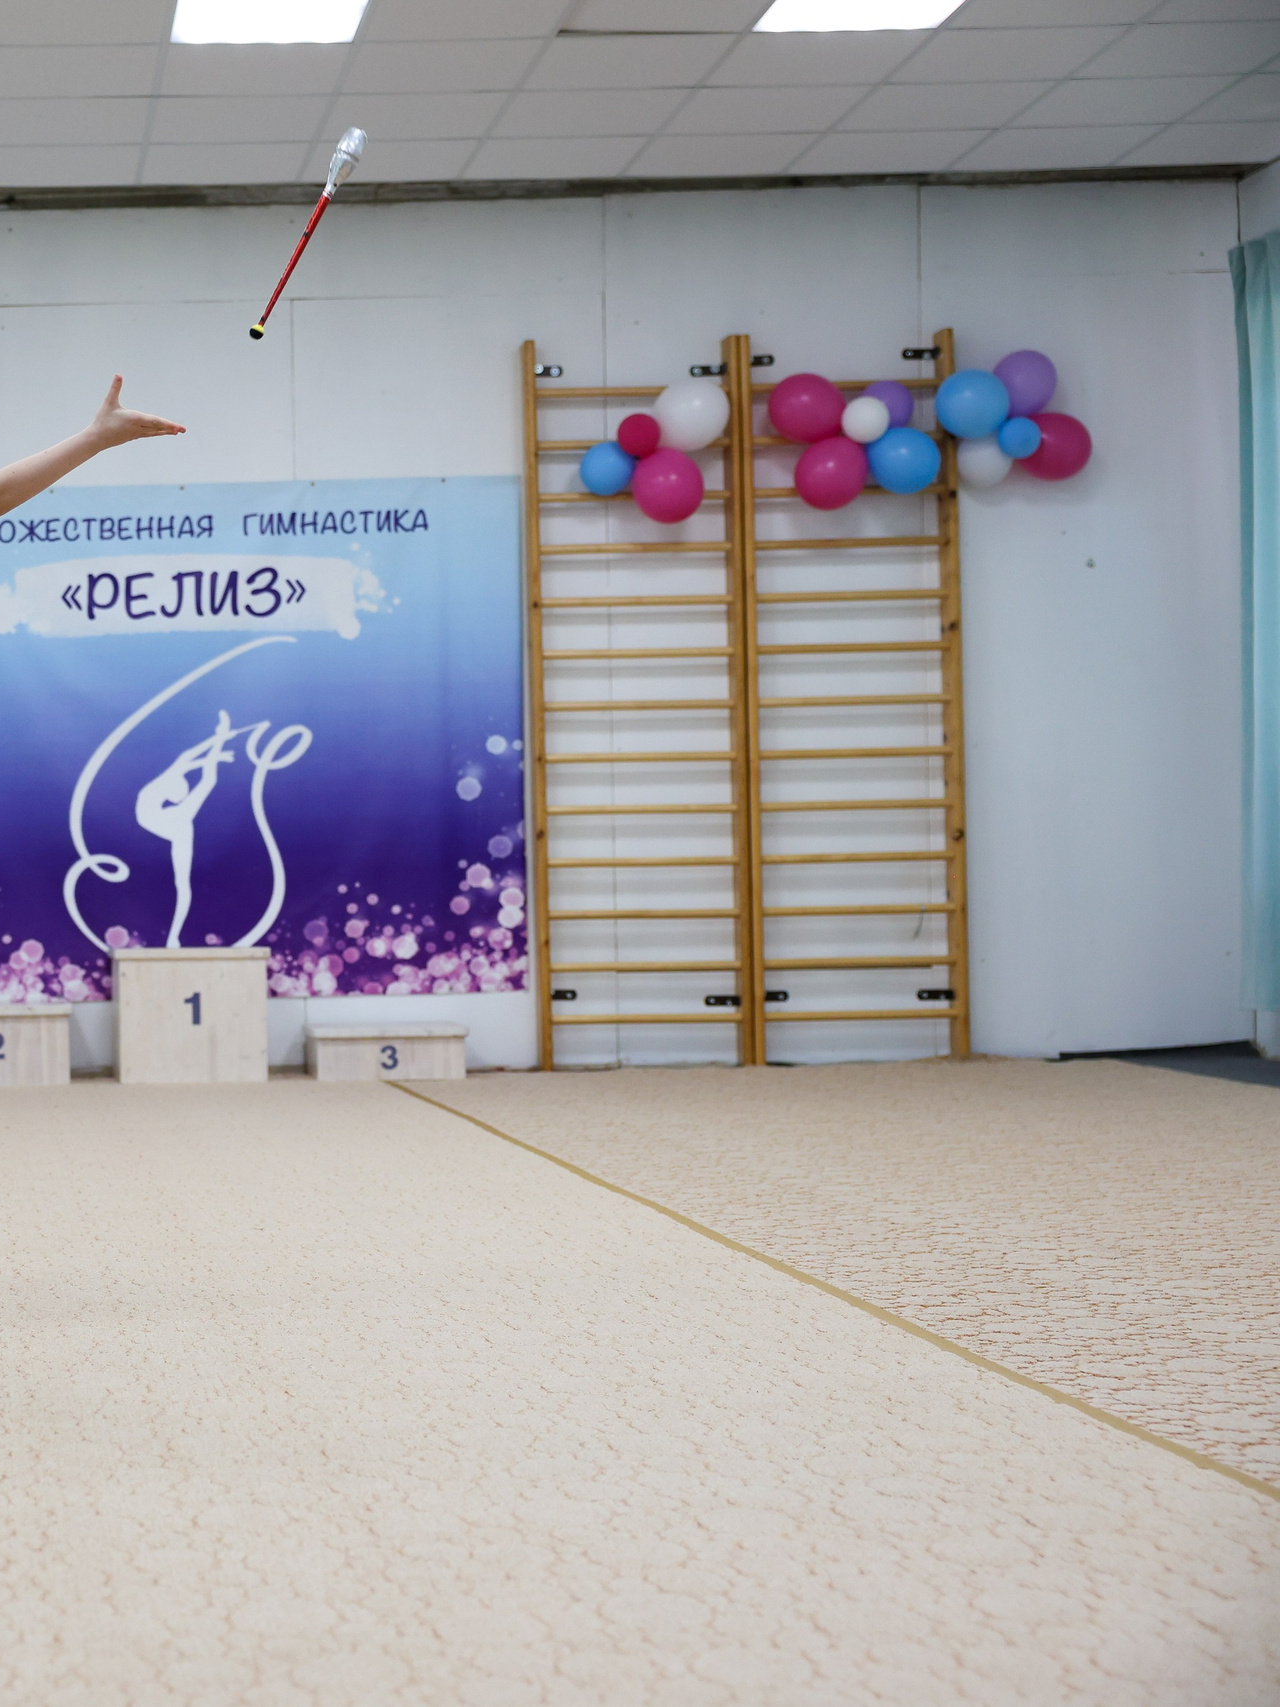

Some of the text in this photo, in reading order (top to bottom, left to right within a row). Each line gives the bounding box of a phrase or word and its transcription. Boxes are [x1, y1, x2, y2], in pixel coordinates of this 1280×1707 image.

[242, 508, 429, 536] ГИМНАСТИКА
[61, 566, 307, 620] «РЕЛИЗ»
[183, 991, 202, 1026] 1
[380, 1044, 399, 1071] 3
